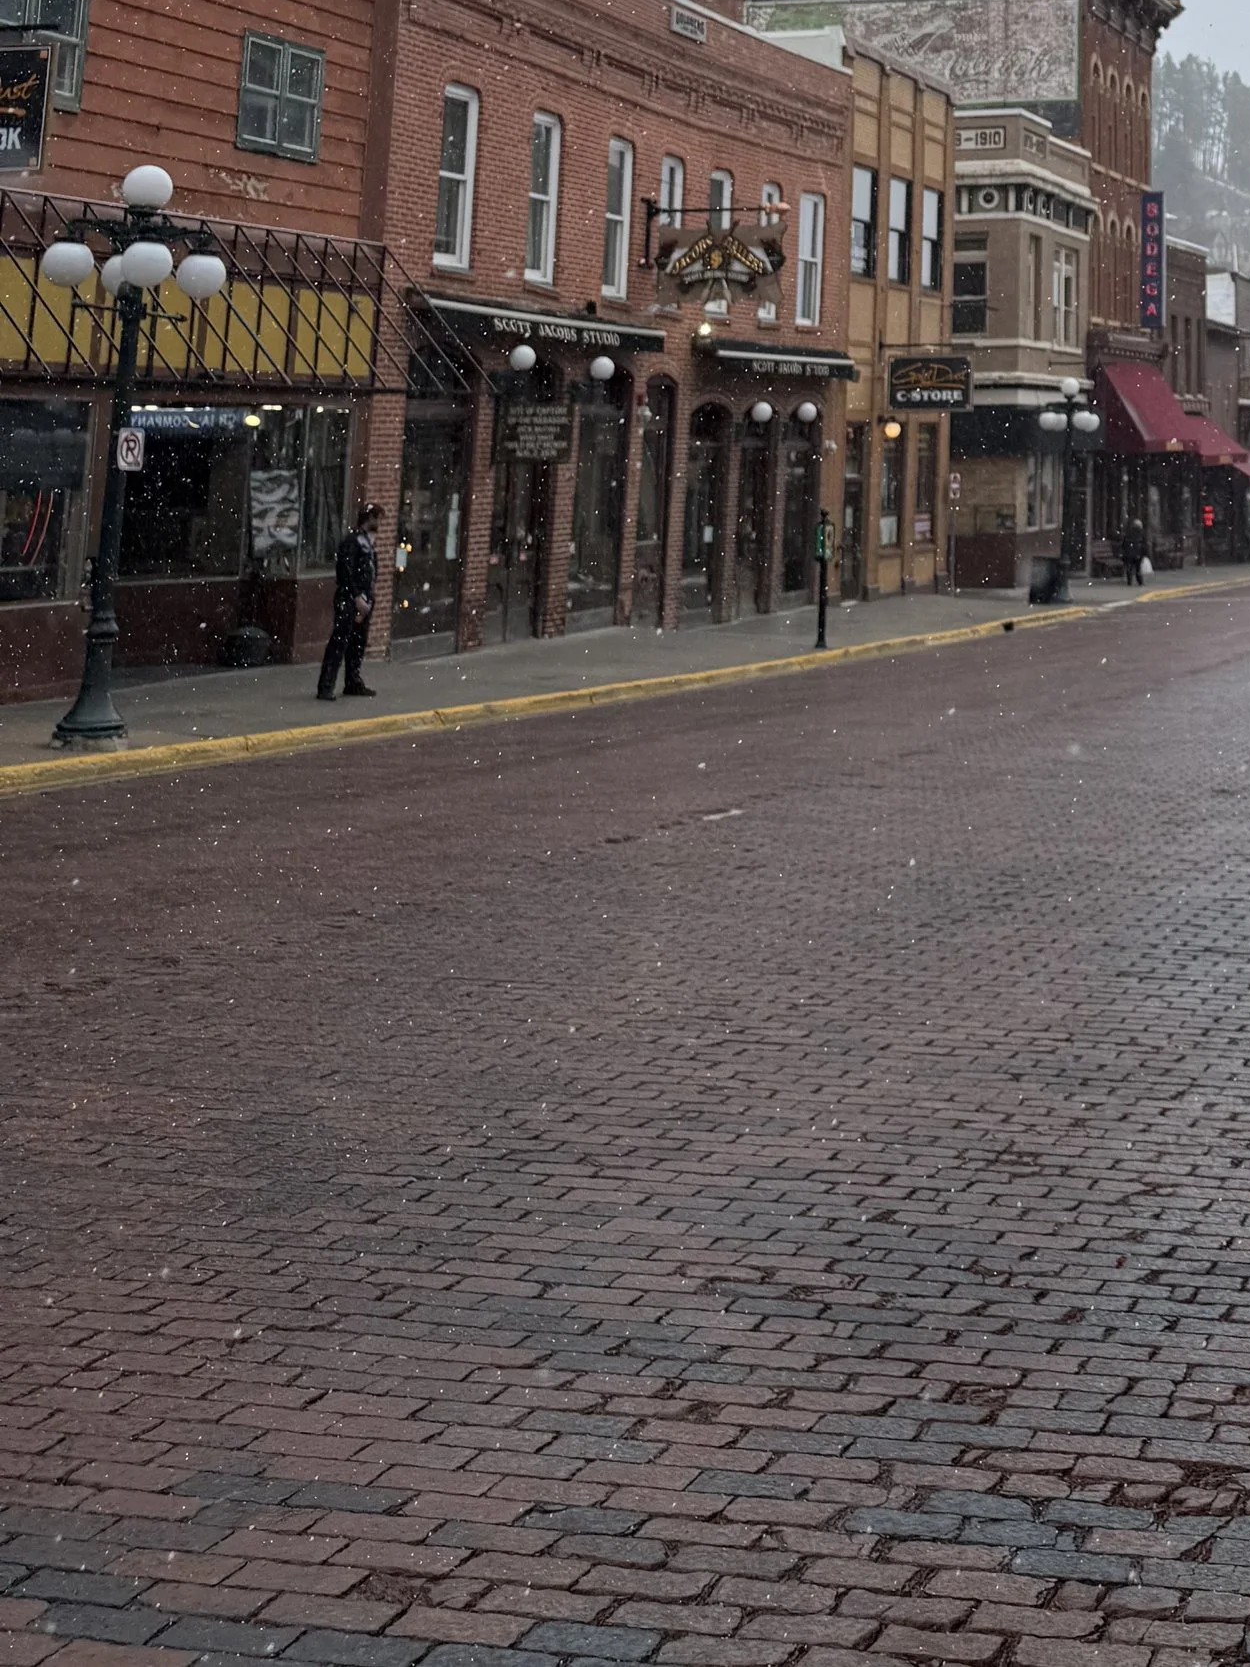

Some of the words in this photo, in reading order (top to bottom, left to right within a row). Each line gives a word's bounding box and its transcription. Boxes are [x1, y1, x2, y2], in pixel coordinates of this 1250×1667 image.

[1145, 202, 1159, 317] BODEGA
[494, 318, 532, 334] SCOTT
[538, 323, 578, 342] JACOBS
[583, 330, 621, 347] STUDIO
[896, 389, 963, 403] C-STORE
